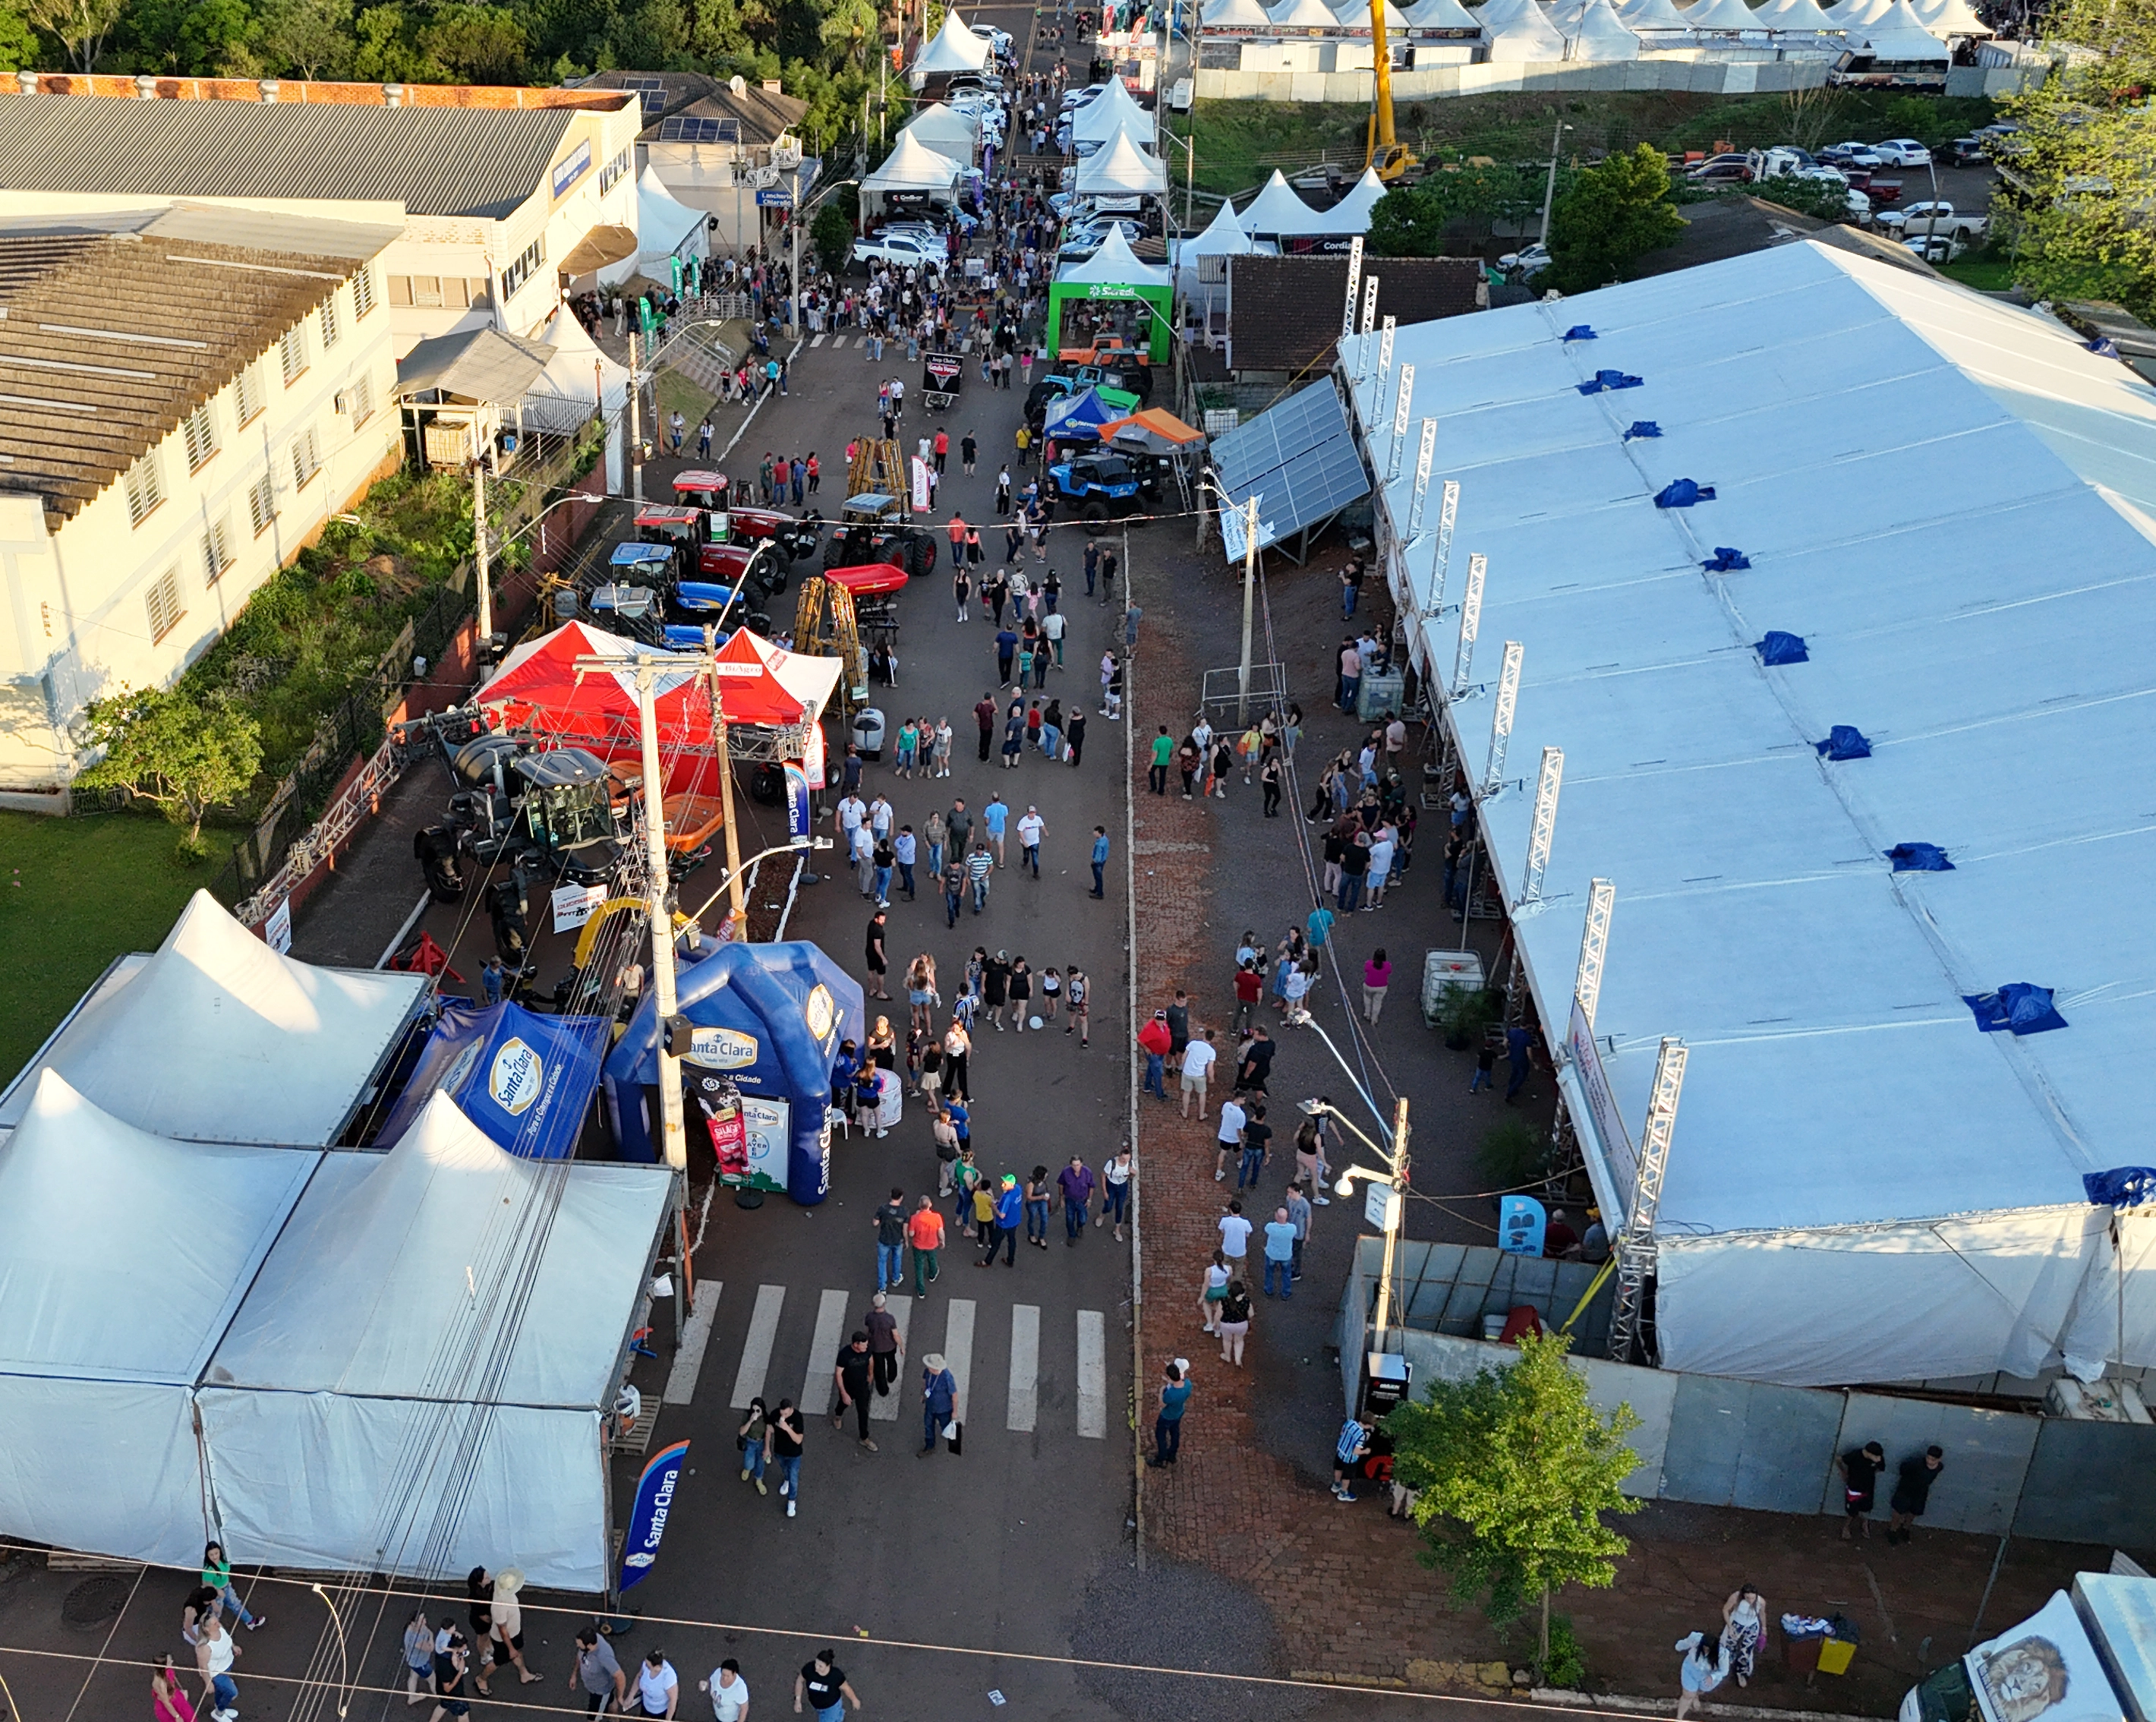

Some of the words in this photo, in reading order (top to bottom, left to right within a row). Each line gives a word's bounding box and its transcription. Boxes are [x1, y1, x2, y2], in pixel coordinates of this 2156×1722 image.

[1102, 287, 1134, 297] Sicredi
[726, 664, 761, 673] BiAgro
[786, 781, 797, 809] Santa
[789, 808, 799, 833] Clara
[691, 1042, 717, 1054] anta
[720, 1042, 753, 1057] Clara
[498, 1071, 523, 1107] Santa
[513, 1049, 533, 1075] Clara
[735, 1074, 761, 1084] Cidade
[757, 1112, 777, 1121] Clara
[820, 1103, 832, 1148] Clara
[818, 1147, 831, 1194] Santa
[654, 1470, 679, 1506] Clara
[644, 1507, 668, 1548] Santa
